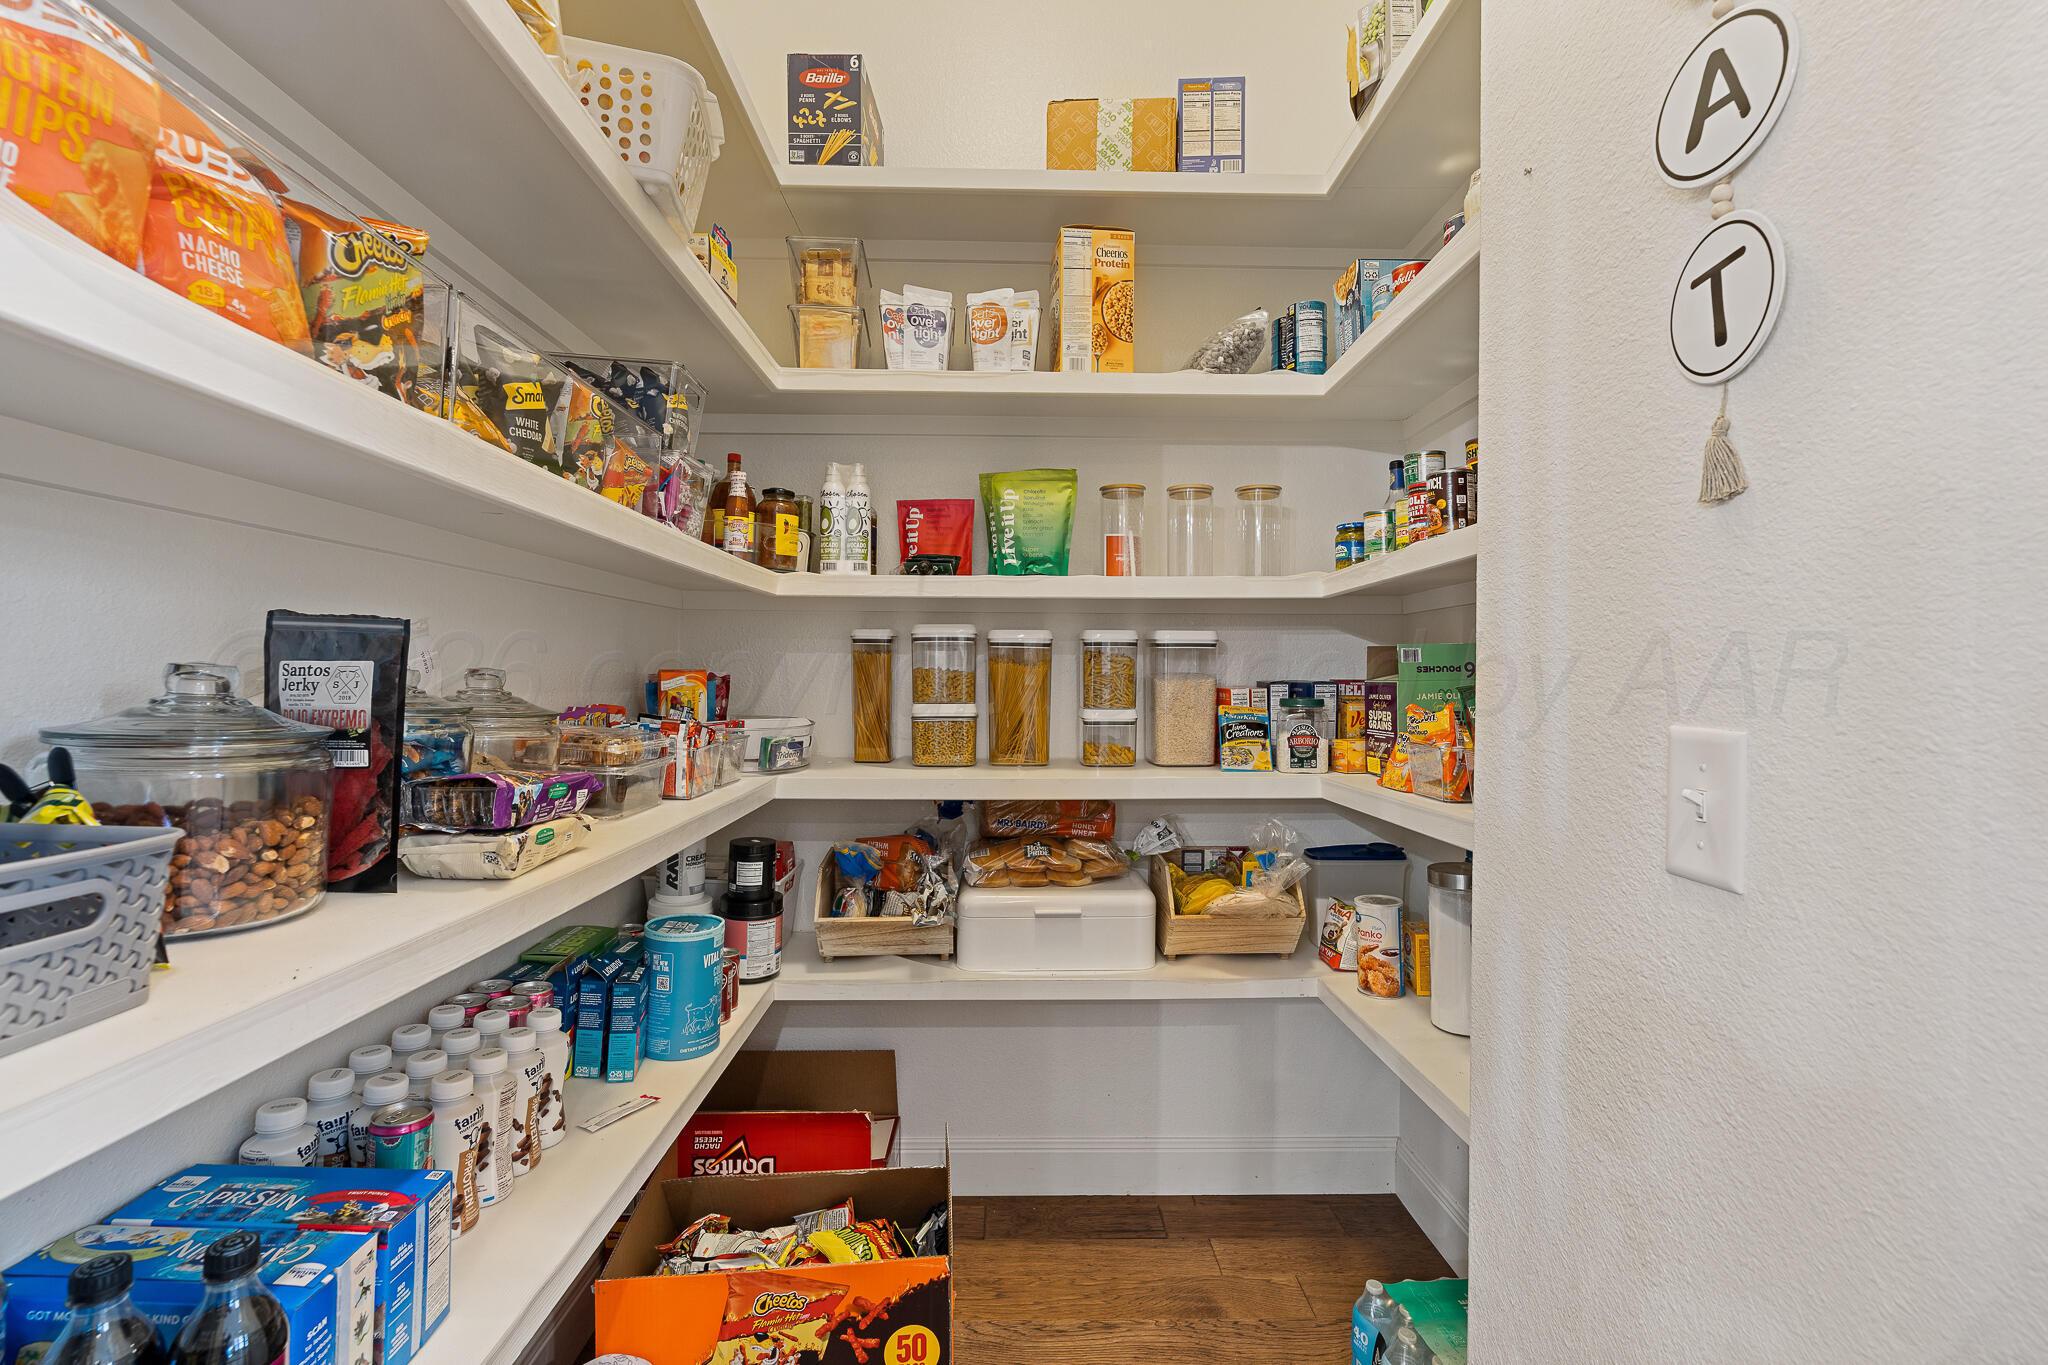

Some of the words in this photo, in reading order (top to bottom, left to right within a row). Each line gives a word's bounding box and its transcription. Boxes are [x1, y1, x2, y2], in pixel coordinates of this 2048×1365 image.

[850, 55, 859, 69] 6
[805, 72, 844, 84] Barilla
[1685, 48, 1751, 154] A
[177, 231, 241, 269] NACHO
[1096, 247, 1129, 259] Cheerios
[181, 251, 245, 289] CHEESE
[1094, 257, 1130, 269] Protein
[1690, 245, 1746, 347] T
[515, 416, 539, 431] WHITE
[509, 426, 543, 443] CHEDDAR
[1000, 487, 1020, 511] Up
[1001, 513, 1016, 527] it
[1002, 528, 1021, 566] Live
[282, 663, 331, 677] Santos
[1417, 665, 1462, 673] POUCHES
[282, 677, 320, 696] Jerky
[332, 681, 340, 689] S
[353, 681, 360, 689] J
[1417, 692, 1443, 700] JAMIE
[311, 708, 367, 730] EXTREMO
[1368, 710, 1392, 721] SUPER
[1228, 723, 1247, 731] Tuna
[1368, 720, 1393, 731] GRAINS
[1226, 729, 1264, 739] Creations
[1289, 738, 1319, 746] ARBORIO
[776, 751, 800, 761] Trident
[997, 819, 1014, 828] MRS
[1072, 822, 1097, 830] HONEY
[1071, 828, 1097, 837] WHEAT
[693, 1158, 775, 1176] Doritos
[463, 1158, 474, 1207] PROTEIN
[753, 1291, 808, 1316] Cheetos
[26, 1310, 51, 1321] GOT
[152, 1314, 180, 1325] KIND
[307, 1317, 328, 1341] SCAN
[896, 1332, 927, 1364] 50
